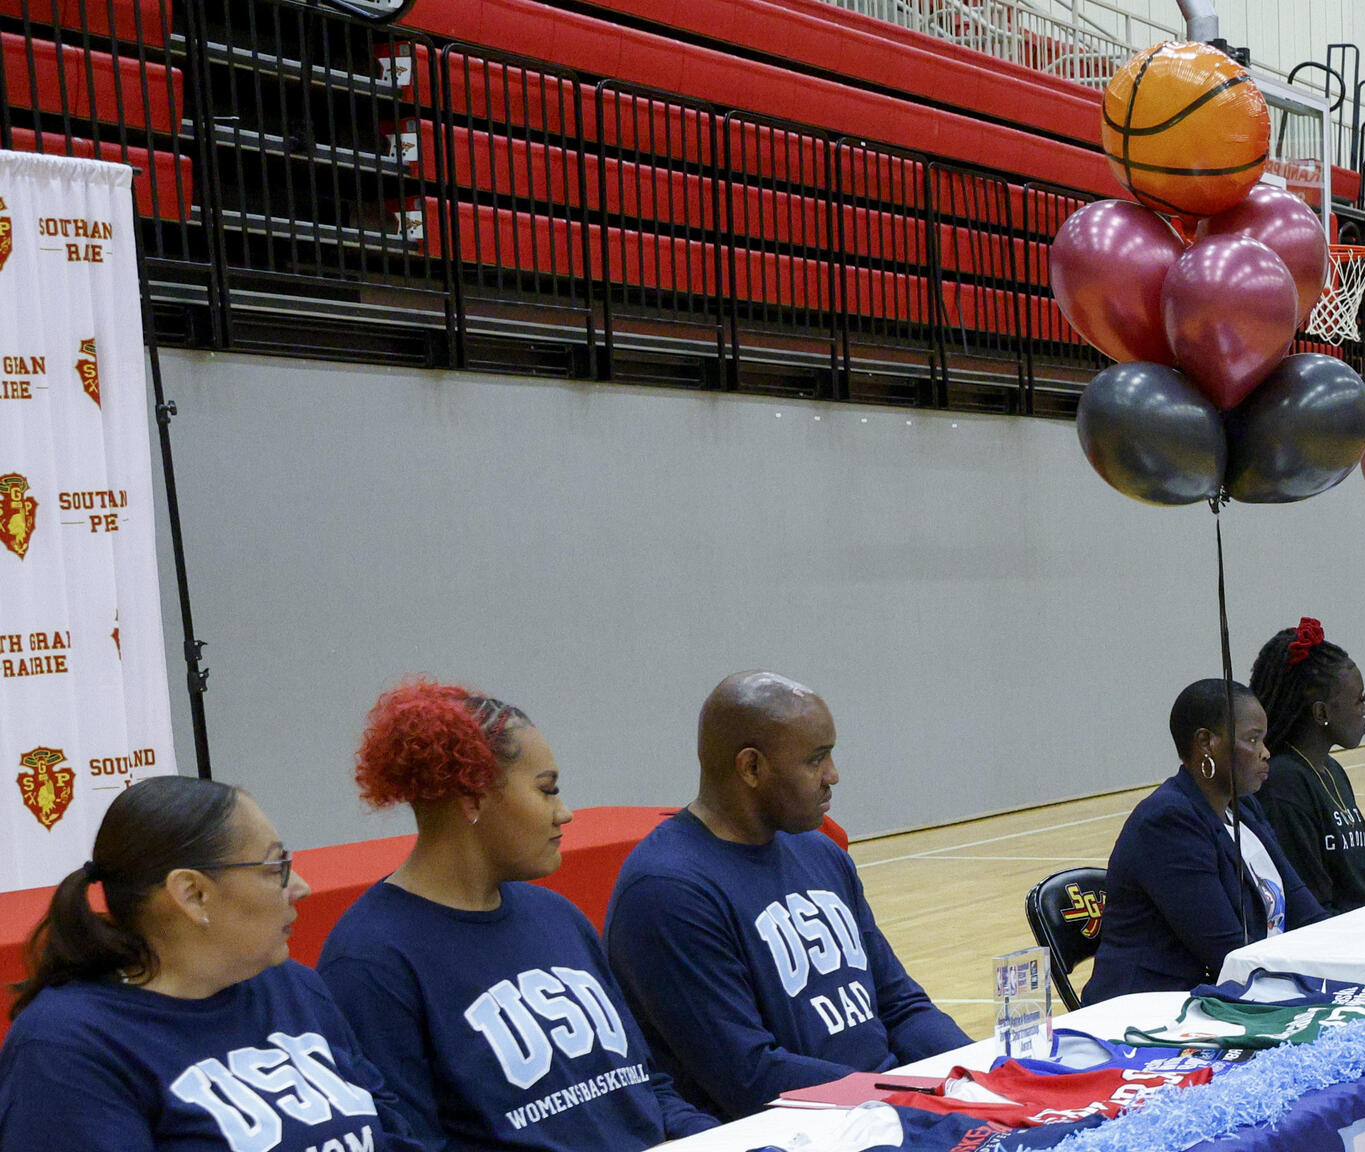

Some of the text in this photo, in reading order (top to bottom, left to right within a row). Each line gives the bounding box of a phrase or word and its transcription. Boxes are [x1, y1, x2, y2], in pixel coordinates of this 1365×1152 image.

[1064, 883, 1106, 919] SG
[755, 889, 867, 998] USD
[463, 966, 628, 1090] USD
[809, 980, 874, 1035] DAD
